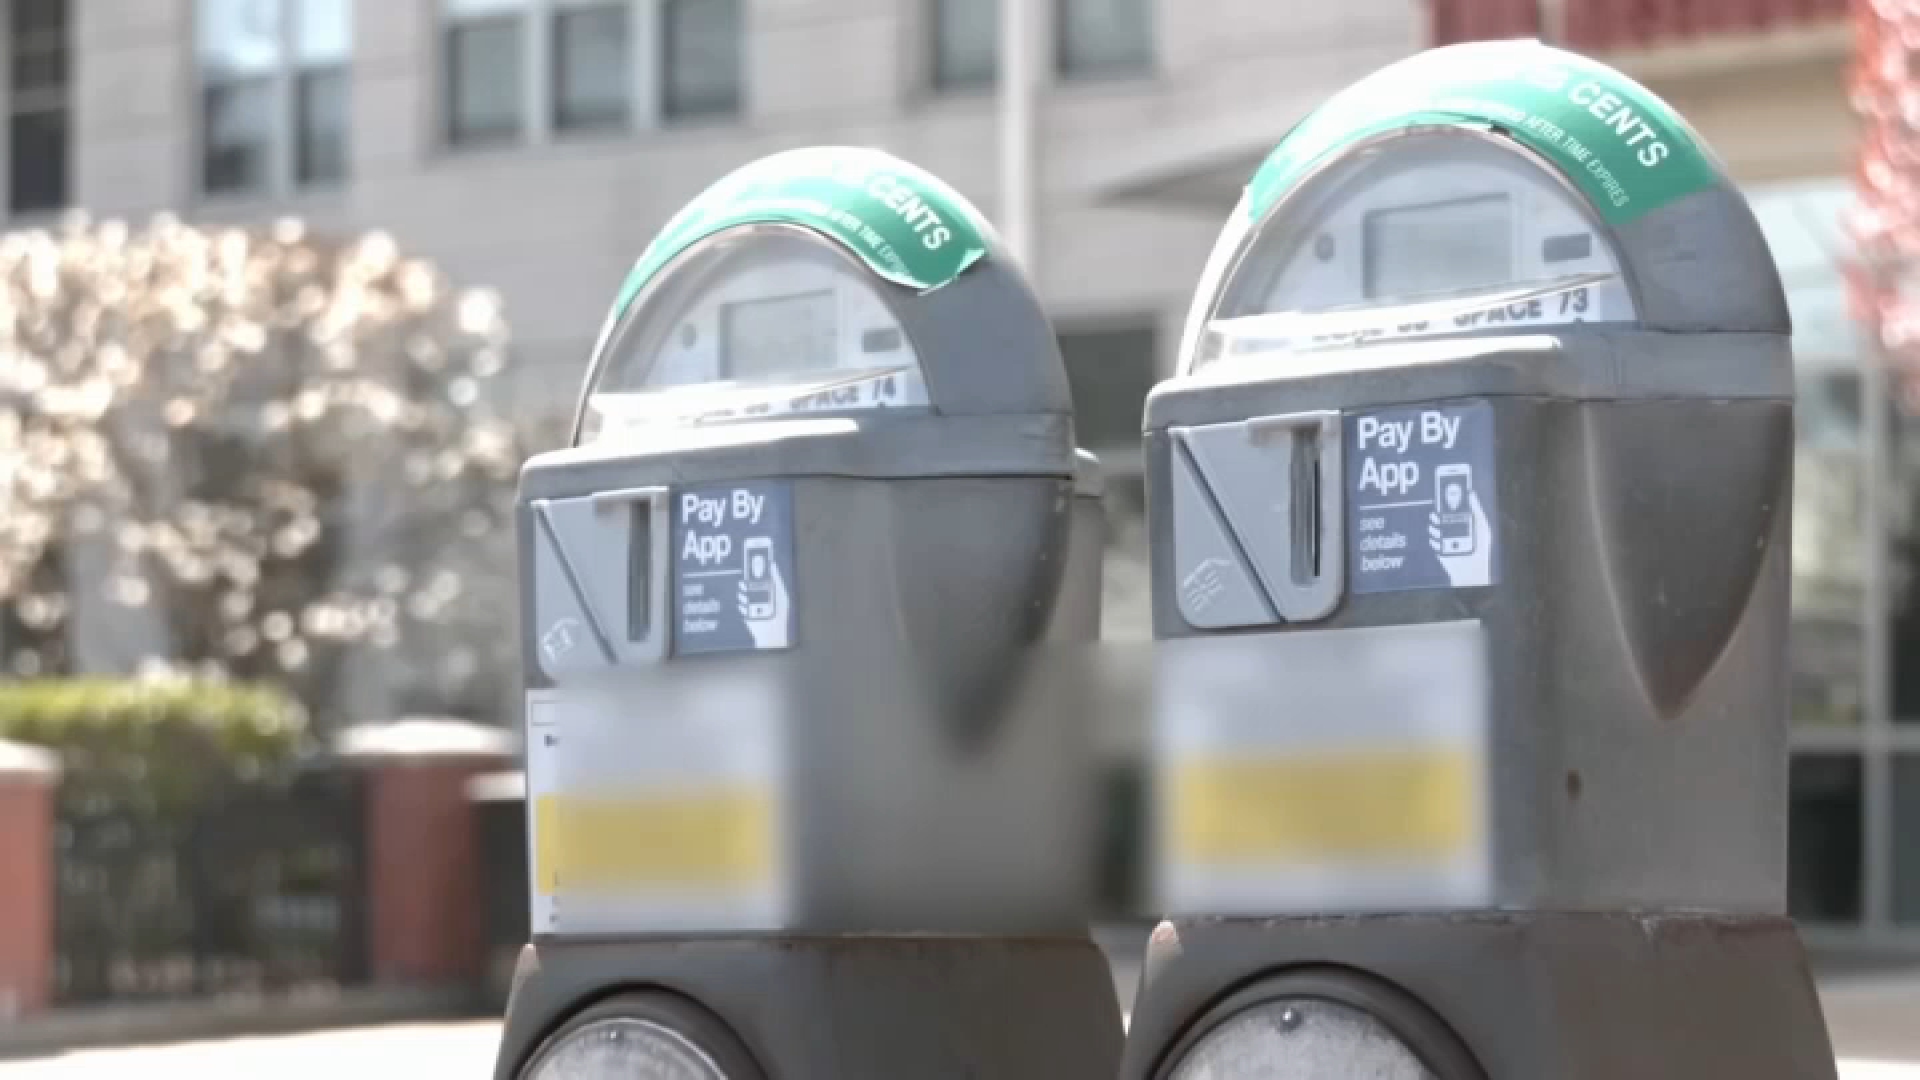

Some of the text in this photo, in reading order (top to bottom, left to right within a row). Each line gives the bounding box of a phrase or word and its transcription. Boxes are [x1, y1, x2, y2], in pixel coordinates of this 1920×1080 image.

[1568, 80, 1669, 168] CENTS
[1524, 114, 1630, 208] AFTER TIME EXPIRES
[868, 174, 951, 250] CENTS
[1558, 287, 1589, 316] 73
[1358, 411, 1461, 453] Pay By
[1358, 456, 1419, 496] App
[682, 488, 765, 528] Pay By
[1359, 517, 1385, 532] see
[682, 529, 731, 565] App
[1359, 531, 1407, 552] details
[1359, 553, 1404, 573] below
